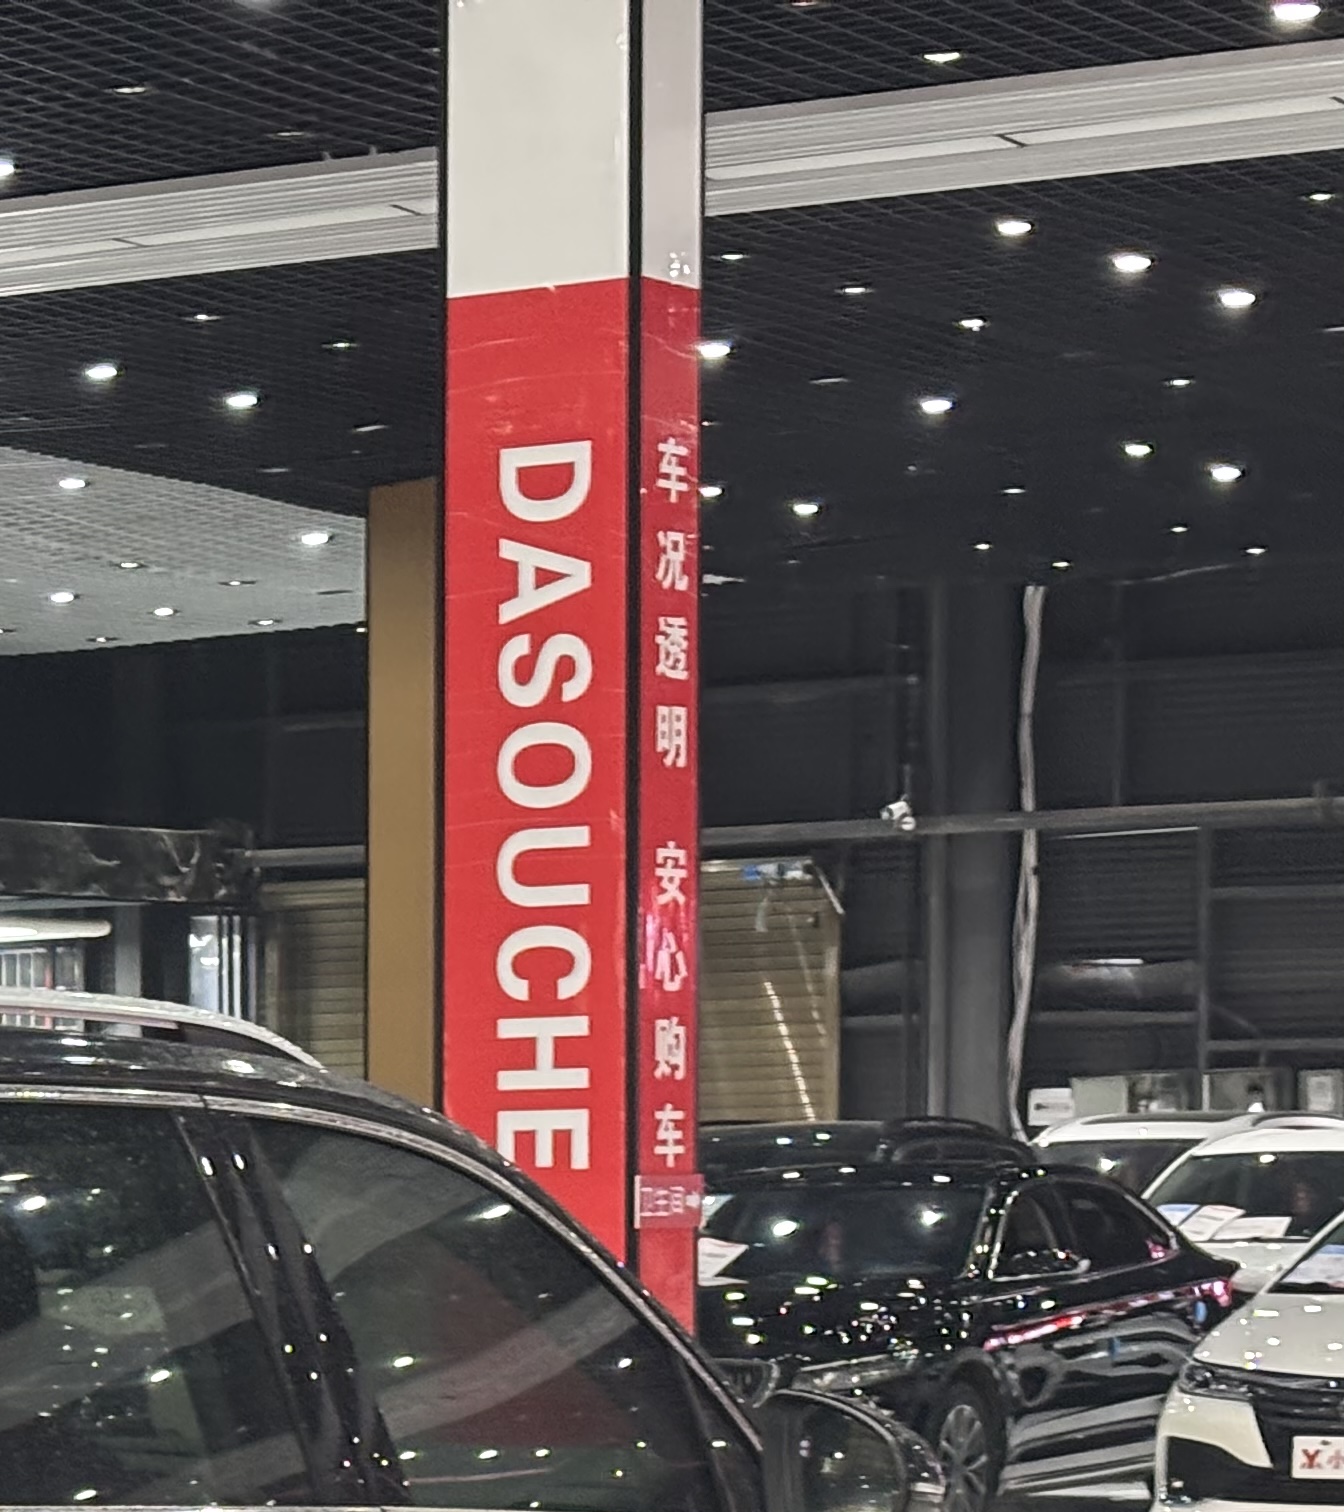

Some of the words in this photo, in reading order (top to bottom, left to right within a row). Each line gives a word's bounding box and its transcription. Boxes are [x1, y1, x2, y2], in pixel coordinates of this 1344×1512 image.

[654, 437, 690, 768] 车况透明
[497, 440, 593, 1170] DASOUCHE
[654, 841, 689, 1167] 安心购车
